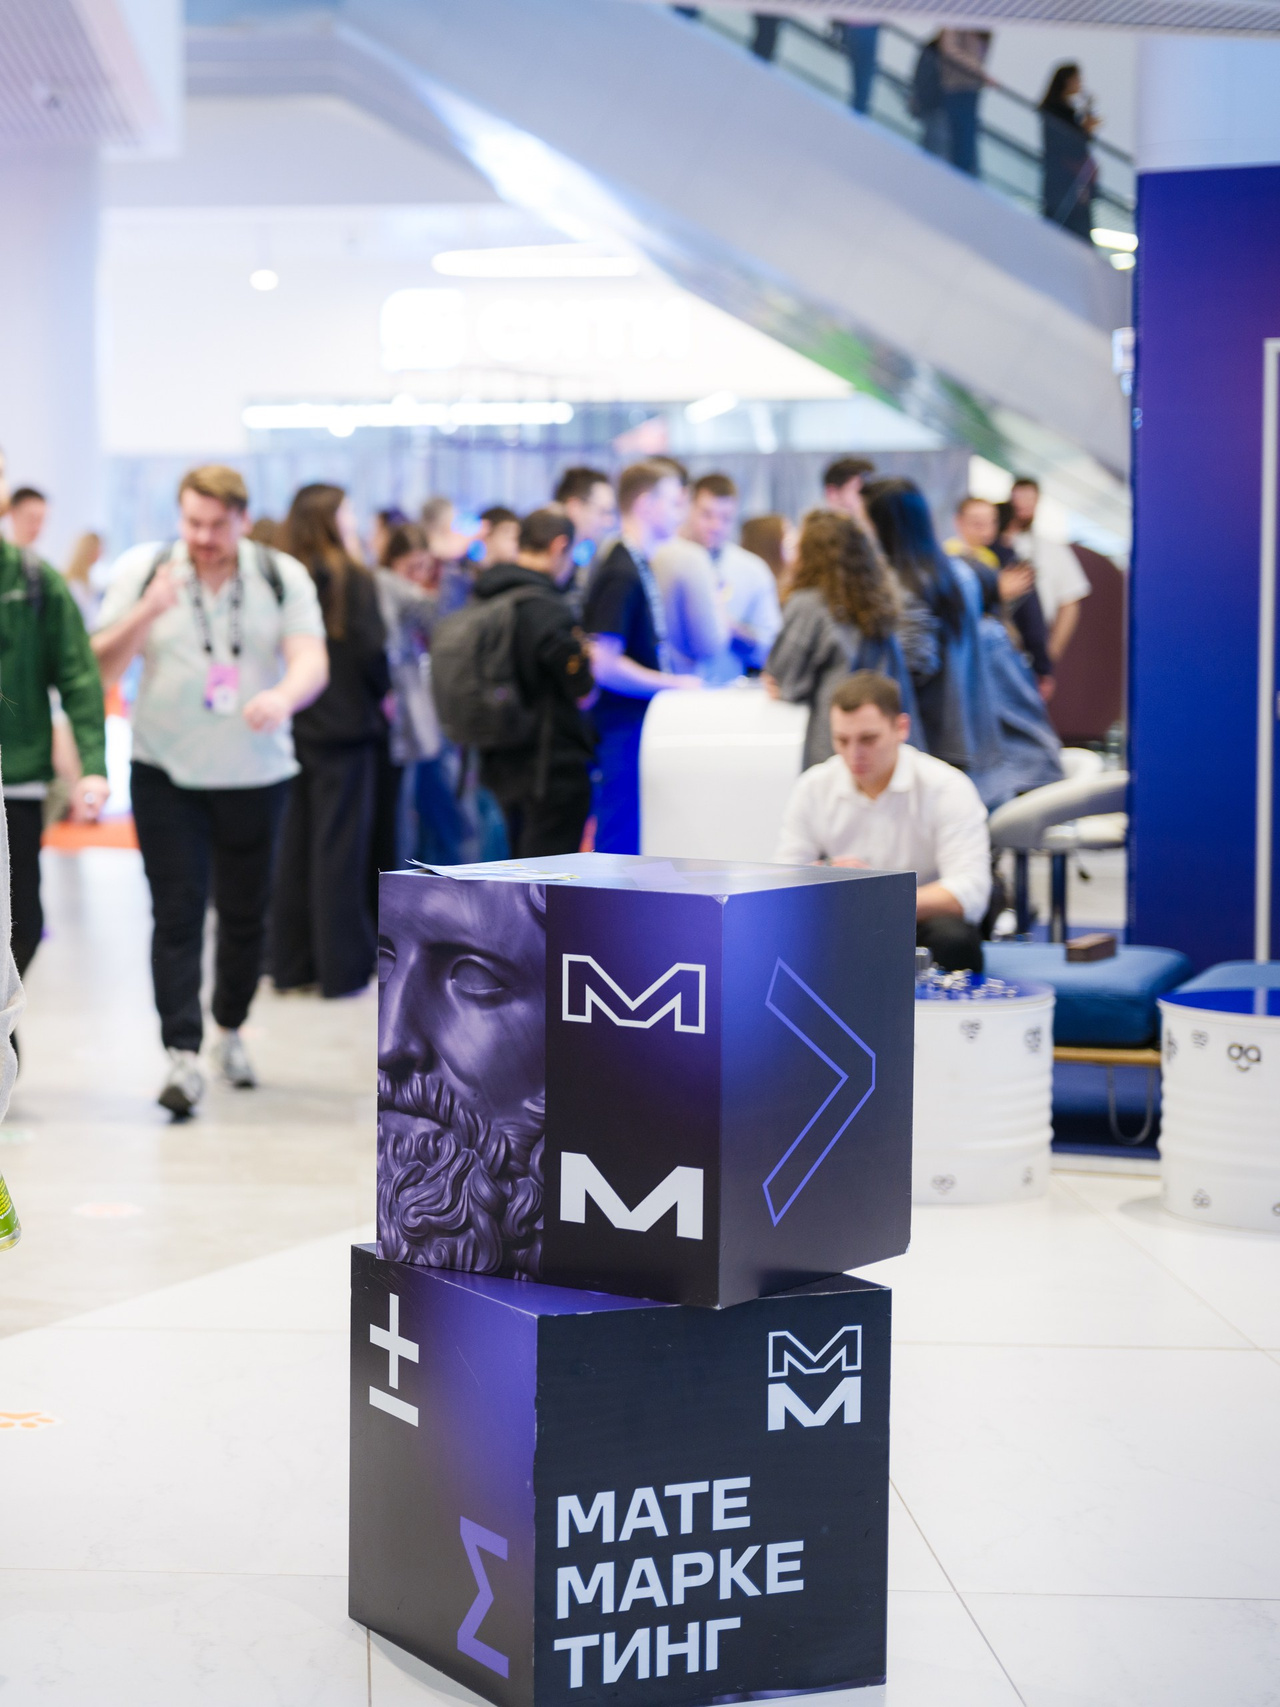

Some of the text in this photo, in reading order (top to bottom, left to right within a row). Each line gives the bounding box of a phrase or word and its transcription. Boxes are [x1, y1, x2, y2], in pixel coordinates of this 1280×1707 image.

[557, 1475, 751, 1548] МАТЕ
[556, 1540, 804, 1619] МАРКЕ
[553, 1616, 741, 1688] ТИНГ
